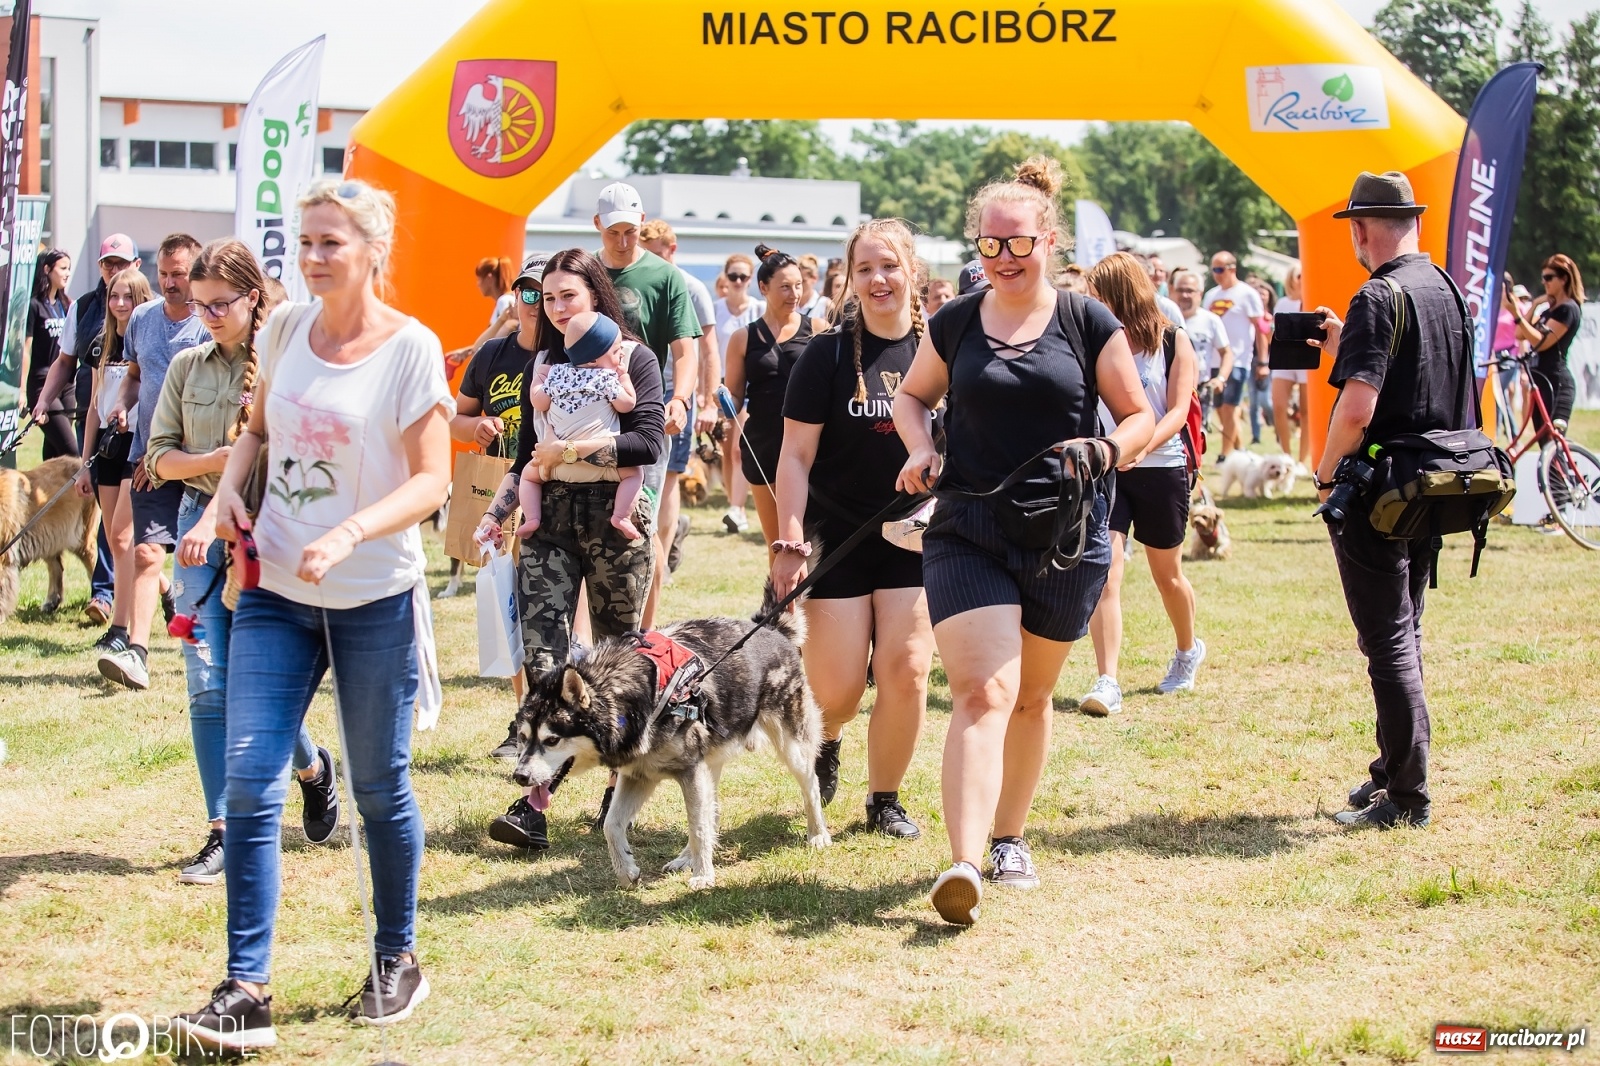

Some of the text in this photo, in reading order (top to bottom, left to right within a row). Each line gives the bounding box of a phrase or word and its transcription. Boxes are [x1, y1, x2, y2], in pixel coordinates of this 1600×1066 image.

[702, 2, 1117, 45] MIASTO RACIBÓRZ
[1263, 91, 1379, 130] Racibórz
[255, 118, 289, 281] opiDog
[471, 485, 496, 498] TropiDo
